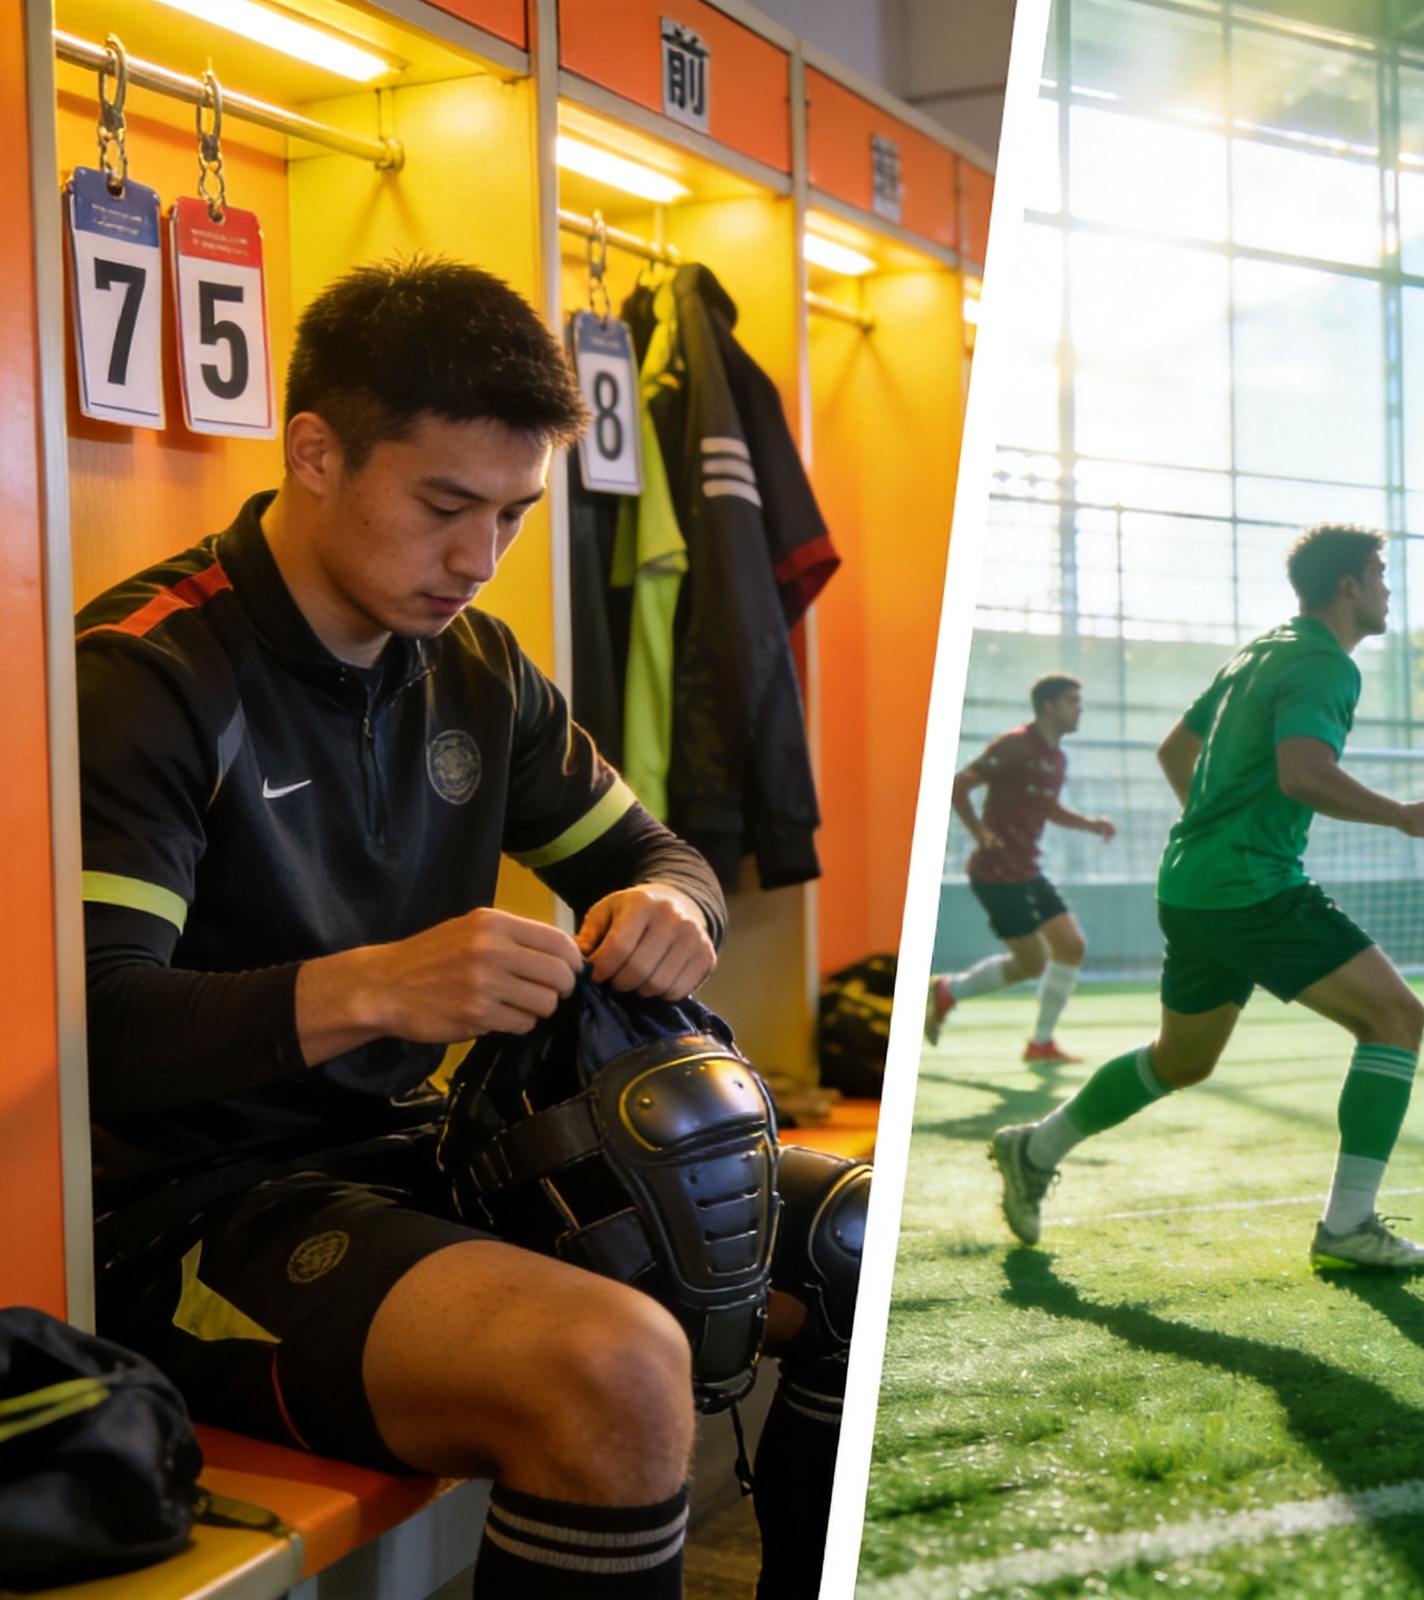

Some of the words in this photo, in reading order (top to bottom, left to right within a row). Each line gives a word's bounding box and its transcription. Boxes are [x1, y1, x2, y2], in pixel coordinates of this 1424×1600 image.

[94, 257, 146, 386] 7
[198, 280, 249, 399] 5
[594, 370, 623, 462] 8
